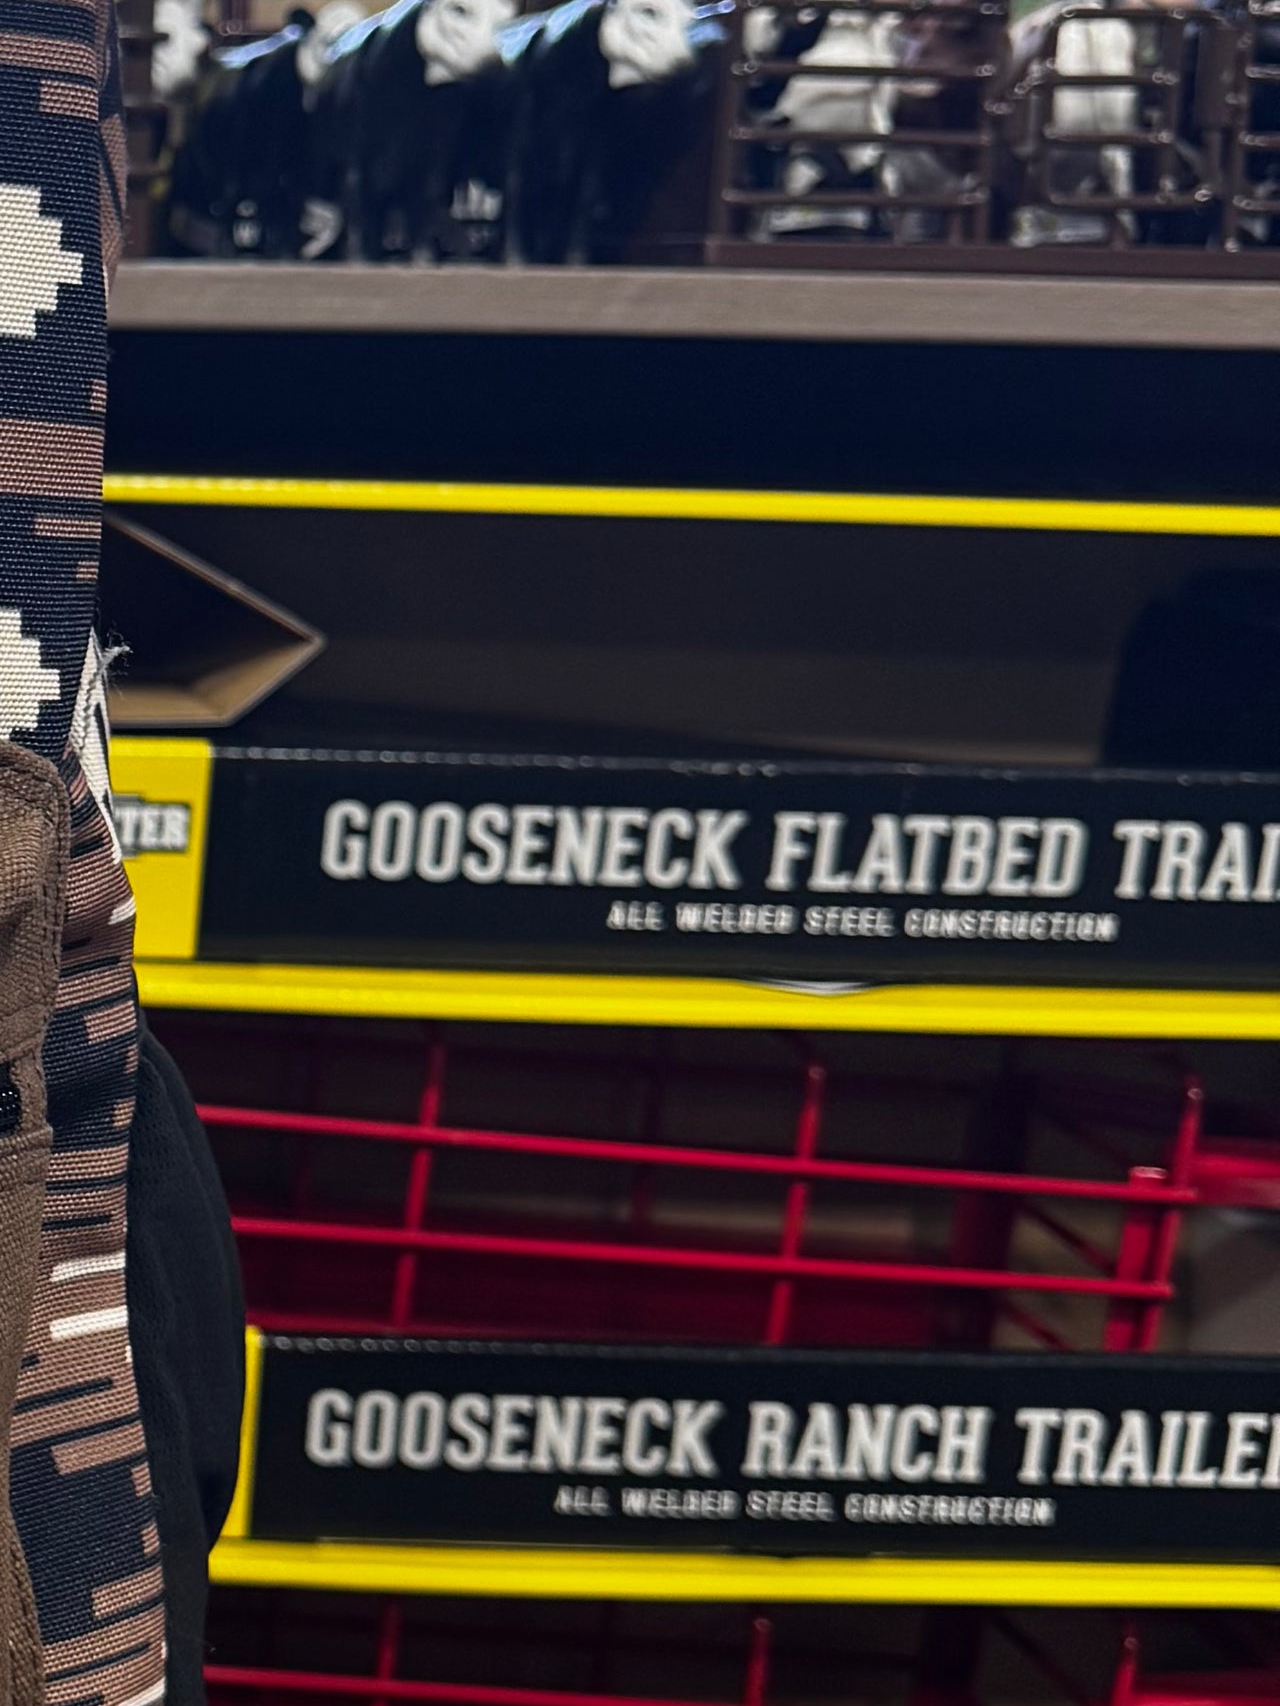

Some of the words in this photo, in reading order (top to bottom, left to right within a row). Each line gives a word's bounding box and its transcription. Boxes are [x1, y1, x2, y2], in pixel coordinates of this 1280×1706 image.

[320, 799, 748, 892] GOOSENECK
[765, 811, 1088, 899] FLATBED
[1113, 819, 1280, 902] TRAI
[606, 899, 665, 932] ALL
[676, 901, 798, 935] WELDED
[803, 906, 899, 939] STEEL
[904, 908, 1120, 944] CONSTRUCTION
[305, 1387, 726, 1478] GOOSENECK
[740, 1401, 992, 1484] RANCH
[553, 1485, 612, 1516] ALL
[620, 1487, 738, 1520] WELDED
[744, 1490, 838, 1522] STEEL
[844, 1493, 1058, 1527] CONSTRUCTION
